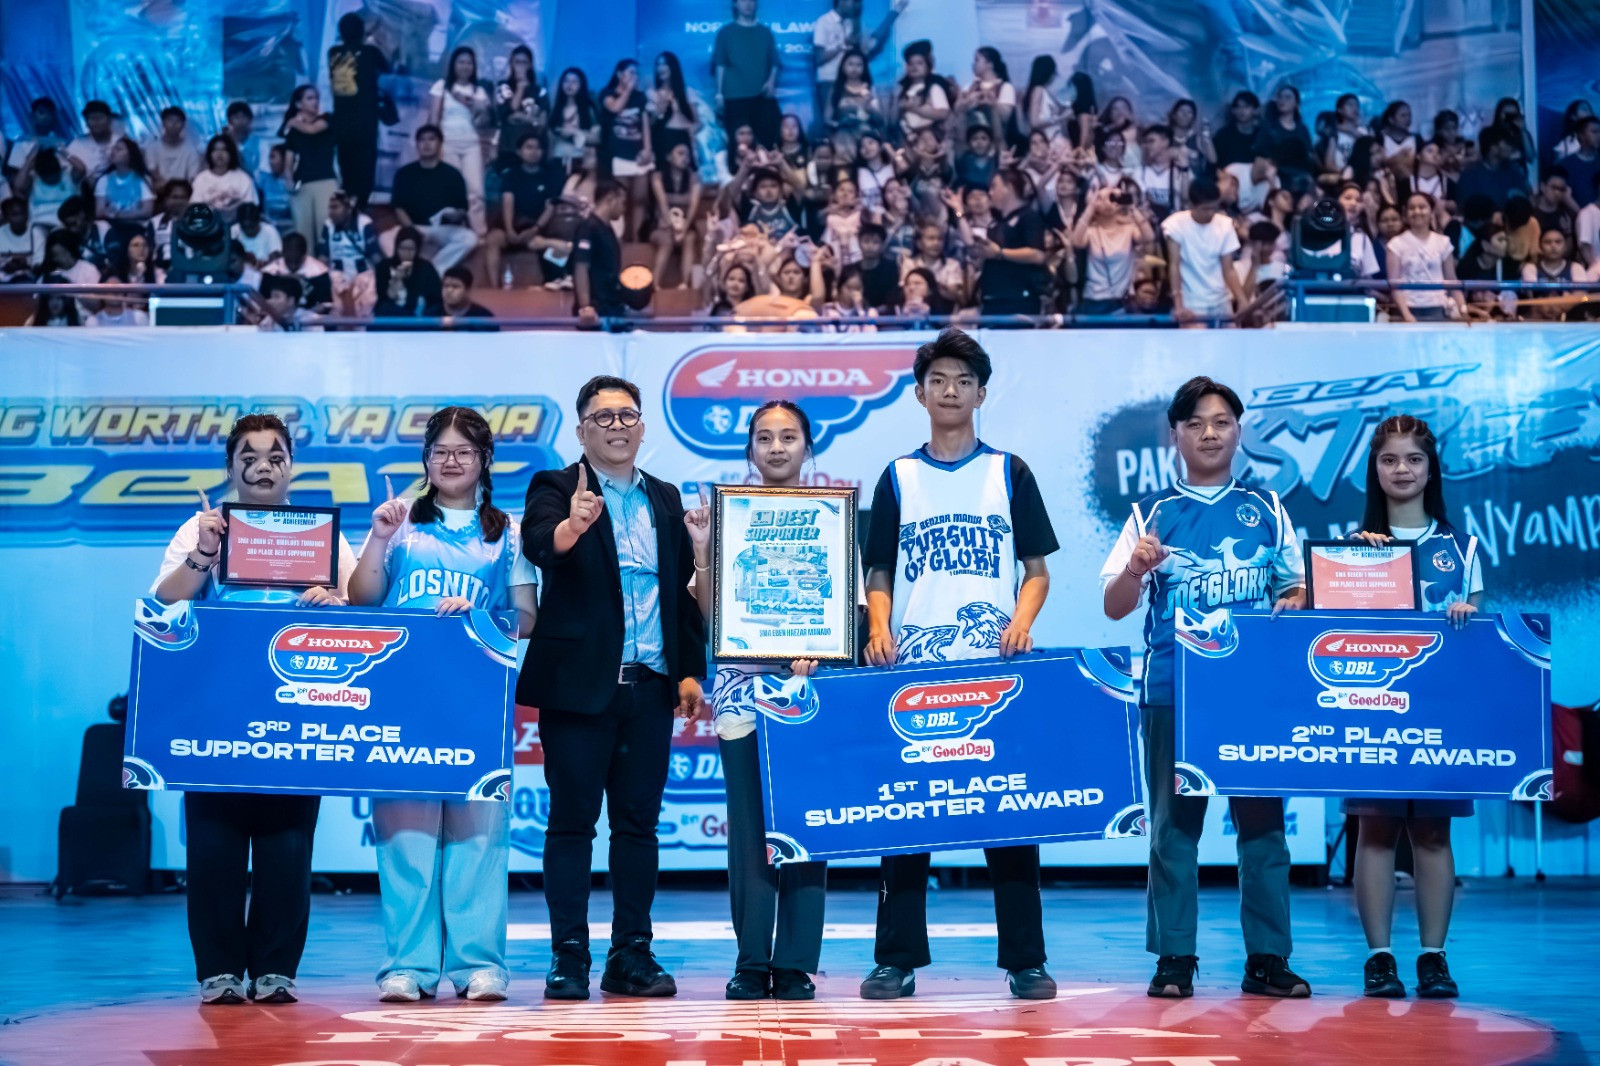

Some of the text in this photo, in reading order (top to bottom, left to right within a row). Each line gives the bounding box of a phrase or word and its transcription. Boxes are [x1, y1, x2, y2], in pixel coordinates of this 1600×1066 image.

[736, 368, 873, 388] HONDA
[51, 406, 238, 443] WORTH
[325, 405, 392, 442] YA
[397, 405, 547, 441] CMA
[776, 508, 820, 527] BEST
[744, 527, 820, 542] SUPPORTER
[901, 525, 1004, 562] PURSUIT
[905, 548, 1000, 582] OF GLORY
[308, 637, 374, 650] HONDA
[1345, 642, 1410, 654] HONDA
[305, 655, 338, 671] DBL
[1344, 661, 1376, 676] DBL
[925, 691, 990, 705] HONDA
[926, 712, 958, 728] DBL
[247, 721, 401, 742] 3RD PLACE
[1291, 725, 1442, 745] 2ND PLACE
[170, 739, 475, 766] SUPPORTER AWARD
[1218, 744, 1517, 767] SUPPORTER AWARD
[878, 772, 1027, 801] 1ST PLACE
[805, 788, 1104, 827] SUPPORTER AWARD
[305, 1026, 1221, 1043] HONDA
